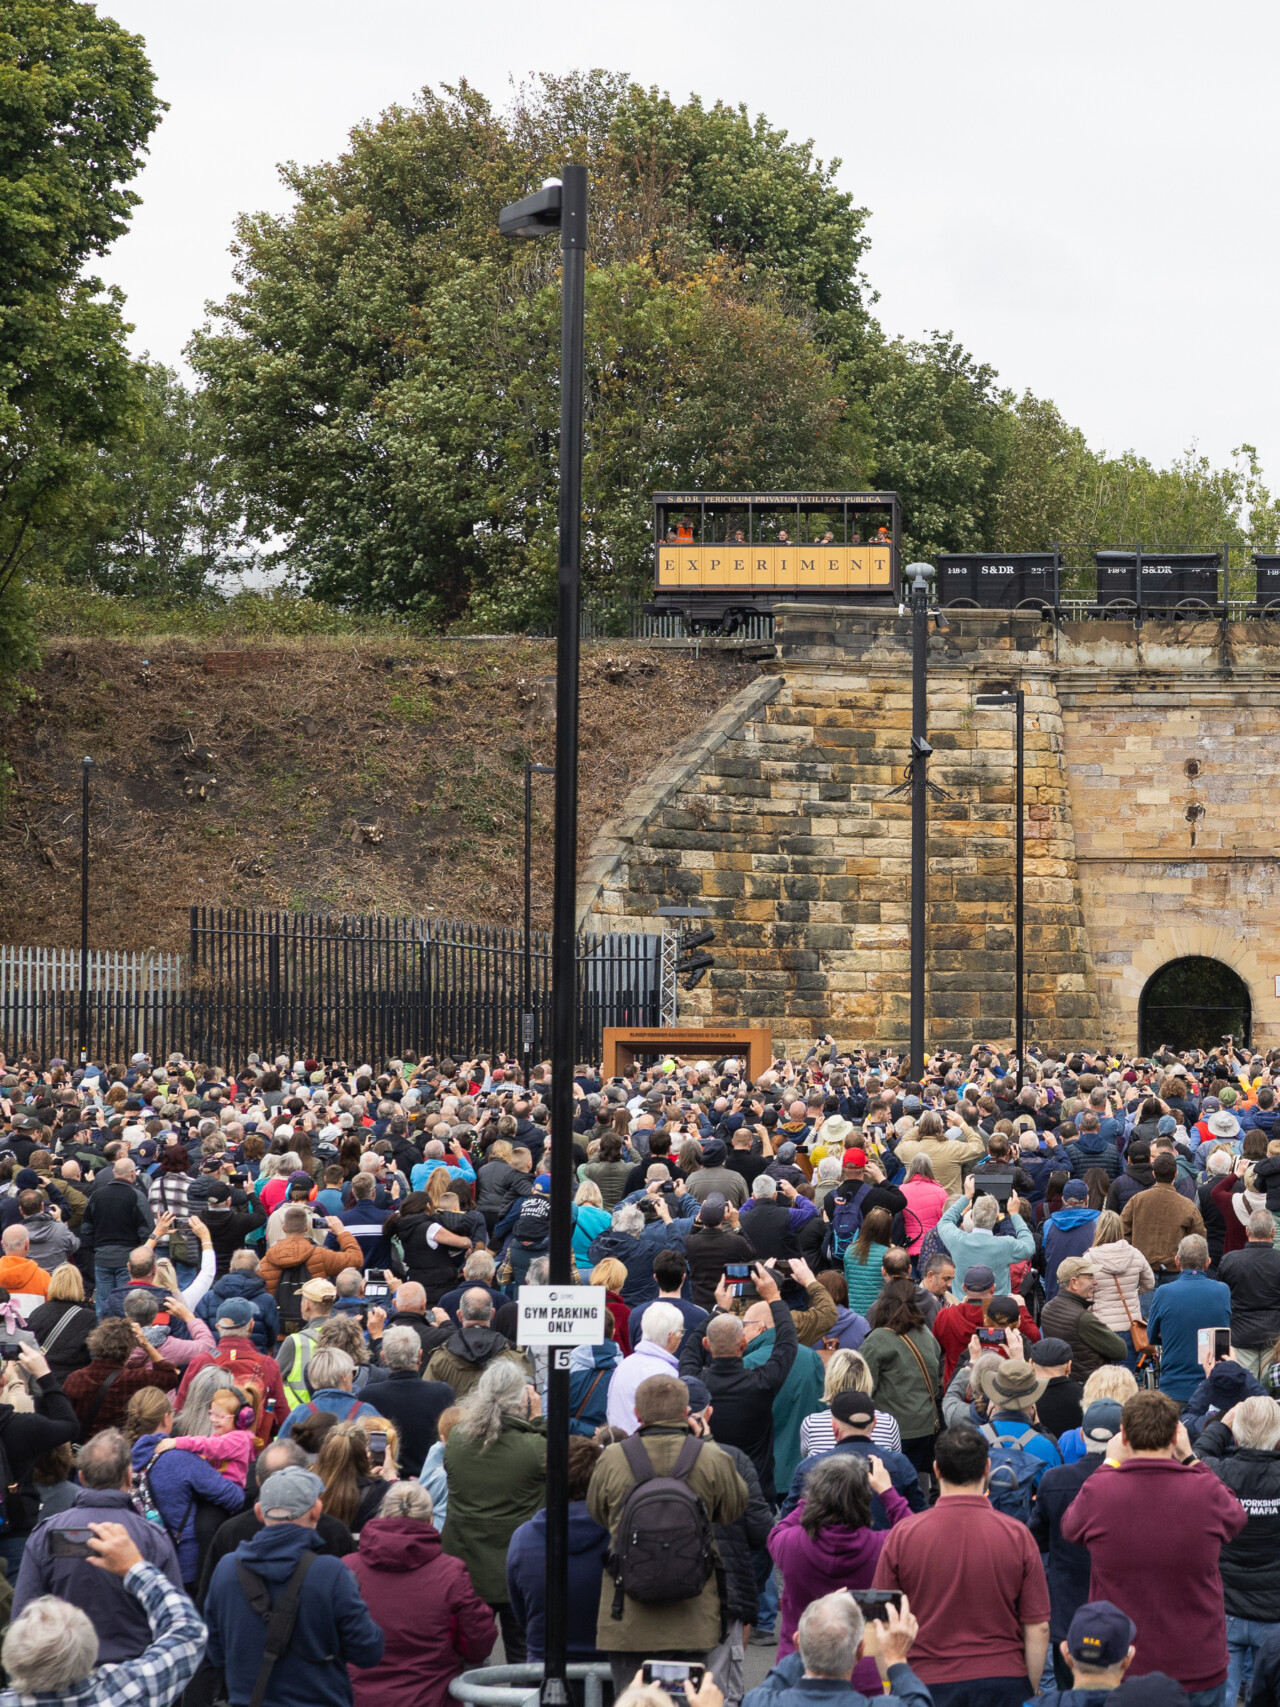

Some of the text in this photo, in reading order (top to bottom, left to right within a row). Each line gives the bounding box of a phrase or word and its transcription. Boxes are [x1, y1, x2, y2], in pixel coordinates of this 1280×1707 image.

[665, 559, 886, 571] EXPERIMENT
[524, 1307, 598, 1319] GYM PARKING
[548, 1321, 574, 1333] ONLY
[558, 1351, 570, 1367] 5
[1250, 1507, 1278, 1515] MAFIA
